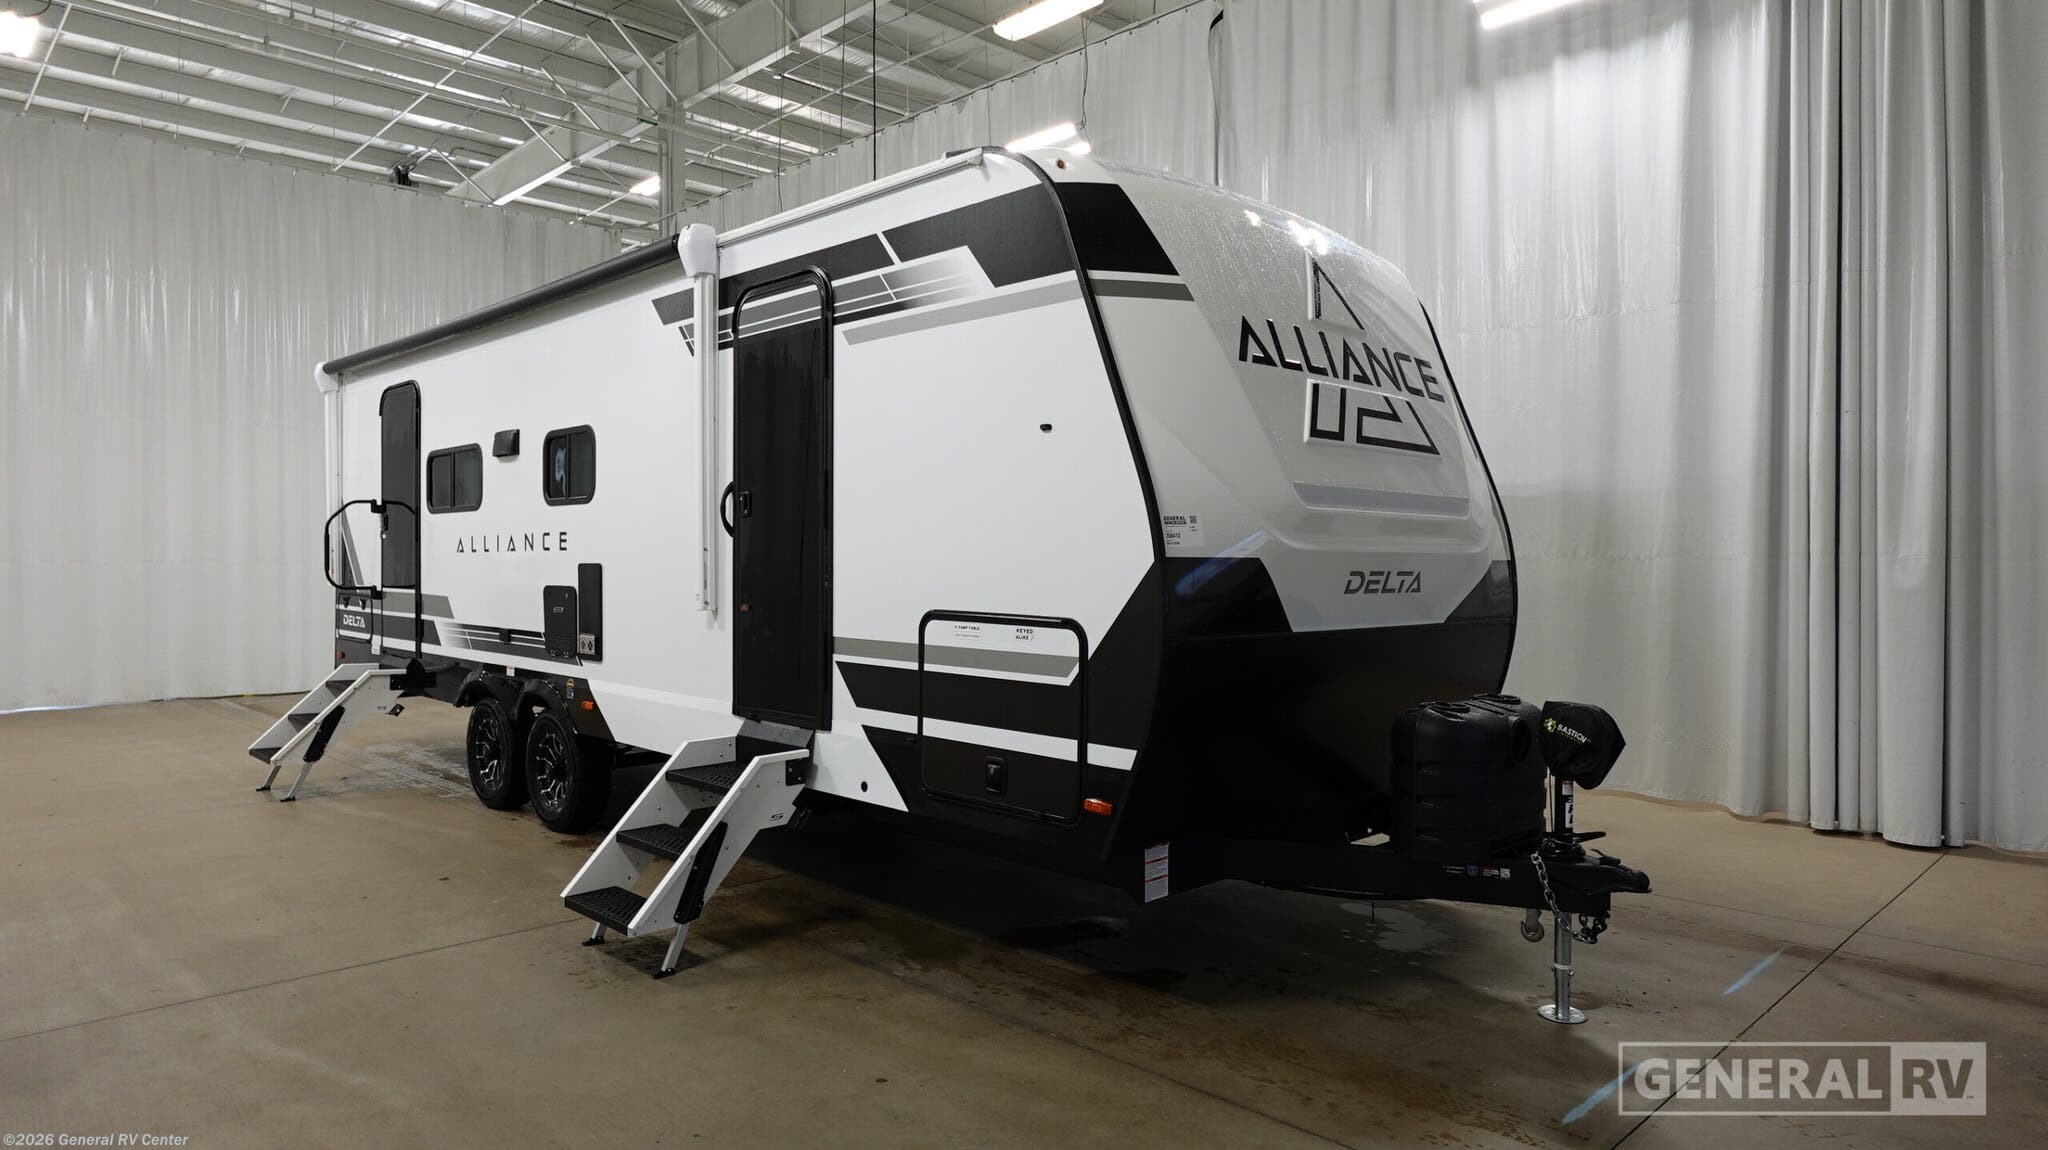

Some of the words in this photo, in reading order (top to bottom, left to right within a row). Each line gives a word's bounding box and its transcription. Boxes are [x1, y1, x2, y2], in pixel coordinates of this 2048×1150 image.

[1239, 315, 1446, 403] ALLIANCE
[456, 532, 567, 553] ALLIANCE
[1344, 570, 1422, 595] DELTA
[343, 614, 366, 628] DELTA
[1557, 723, 1588, 744] BASTION
